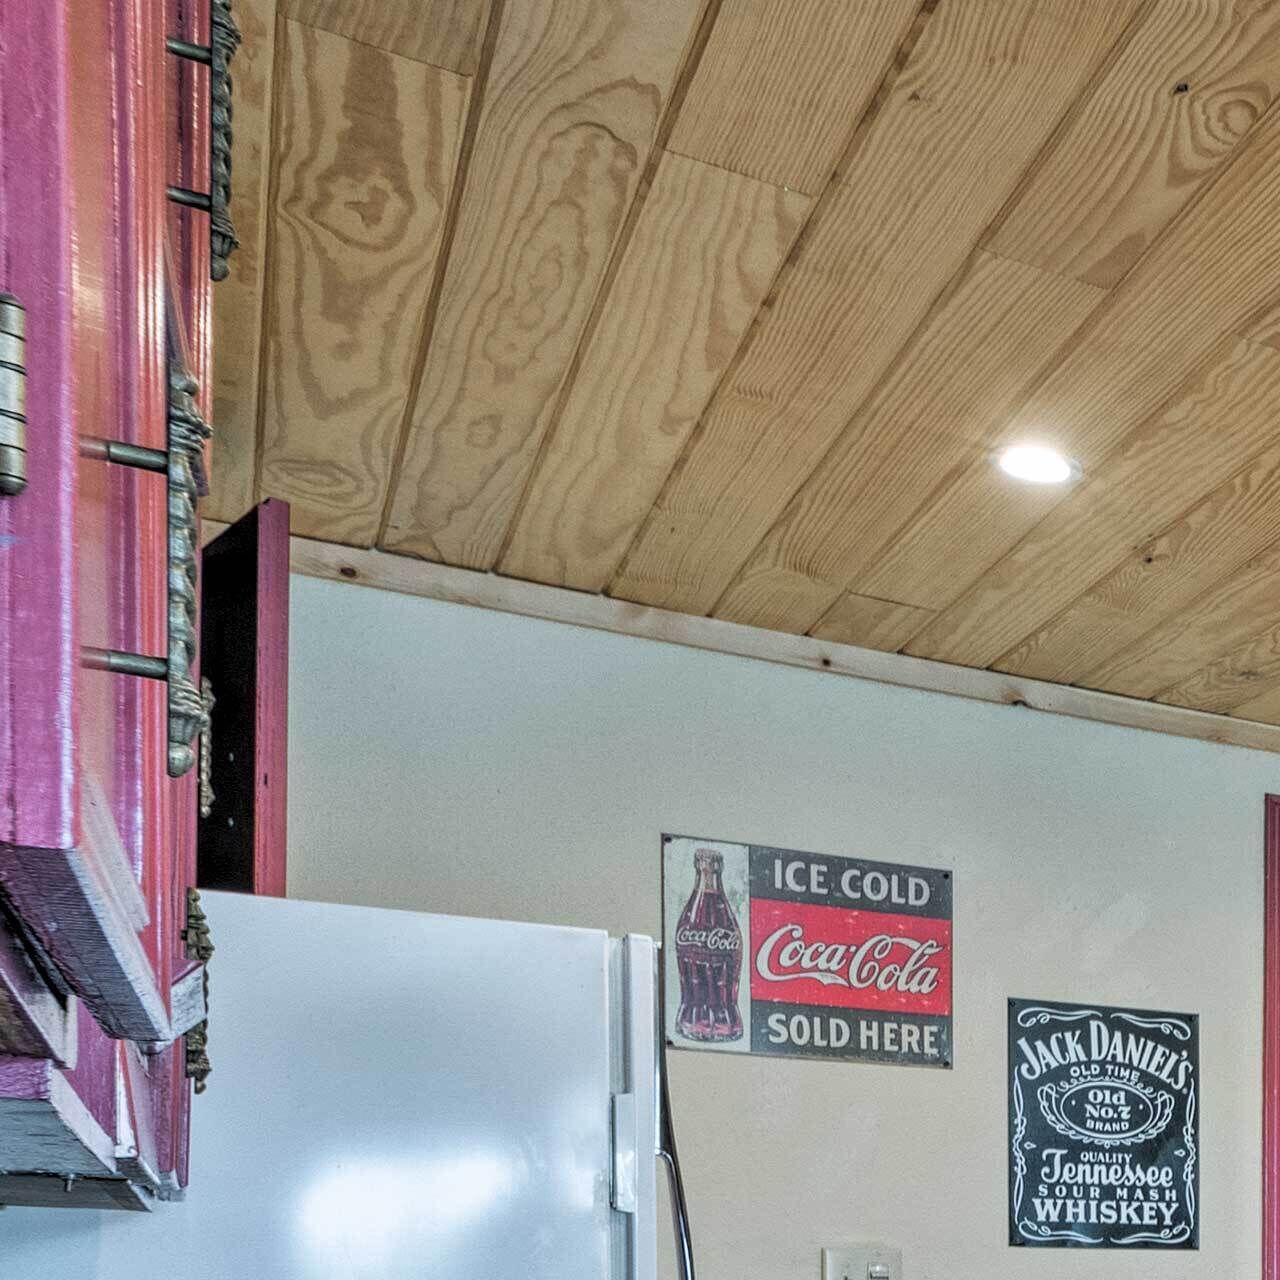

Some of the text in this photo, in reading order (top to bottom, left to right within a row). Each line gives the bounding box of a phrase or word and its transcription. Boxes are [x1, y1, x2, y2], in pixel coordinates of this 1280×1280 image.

[774, 859, 931, 906] ICE COLD
[756, 923, 943, 995] Coca-Cola
[767, 1012, 940, 1055] SOLD HERE
[1016, 1019, 1194, 1091] JACK DANIEL'S
[1069, 1064, 1141, 1082] OLD TIME
[1087, 1089, 1126, 1105] Old
[1085, 1118, 1130, 1132] BRAND
[1040, 1148, 1174, 1188] Tennessee
[1080, 1151, 1133, 1164] QUALITY
[1038, 1184, 1177, 1201] SOUR MASH
[1032, 1198, 1179, 1226] WHISKEY
